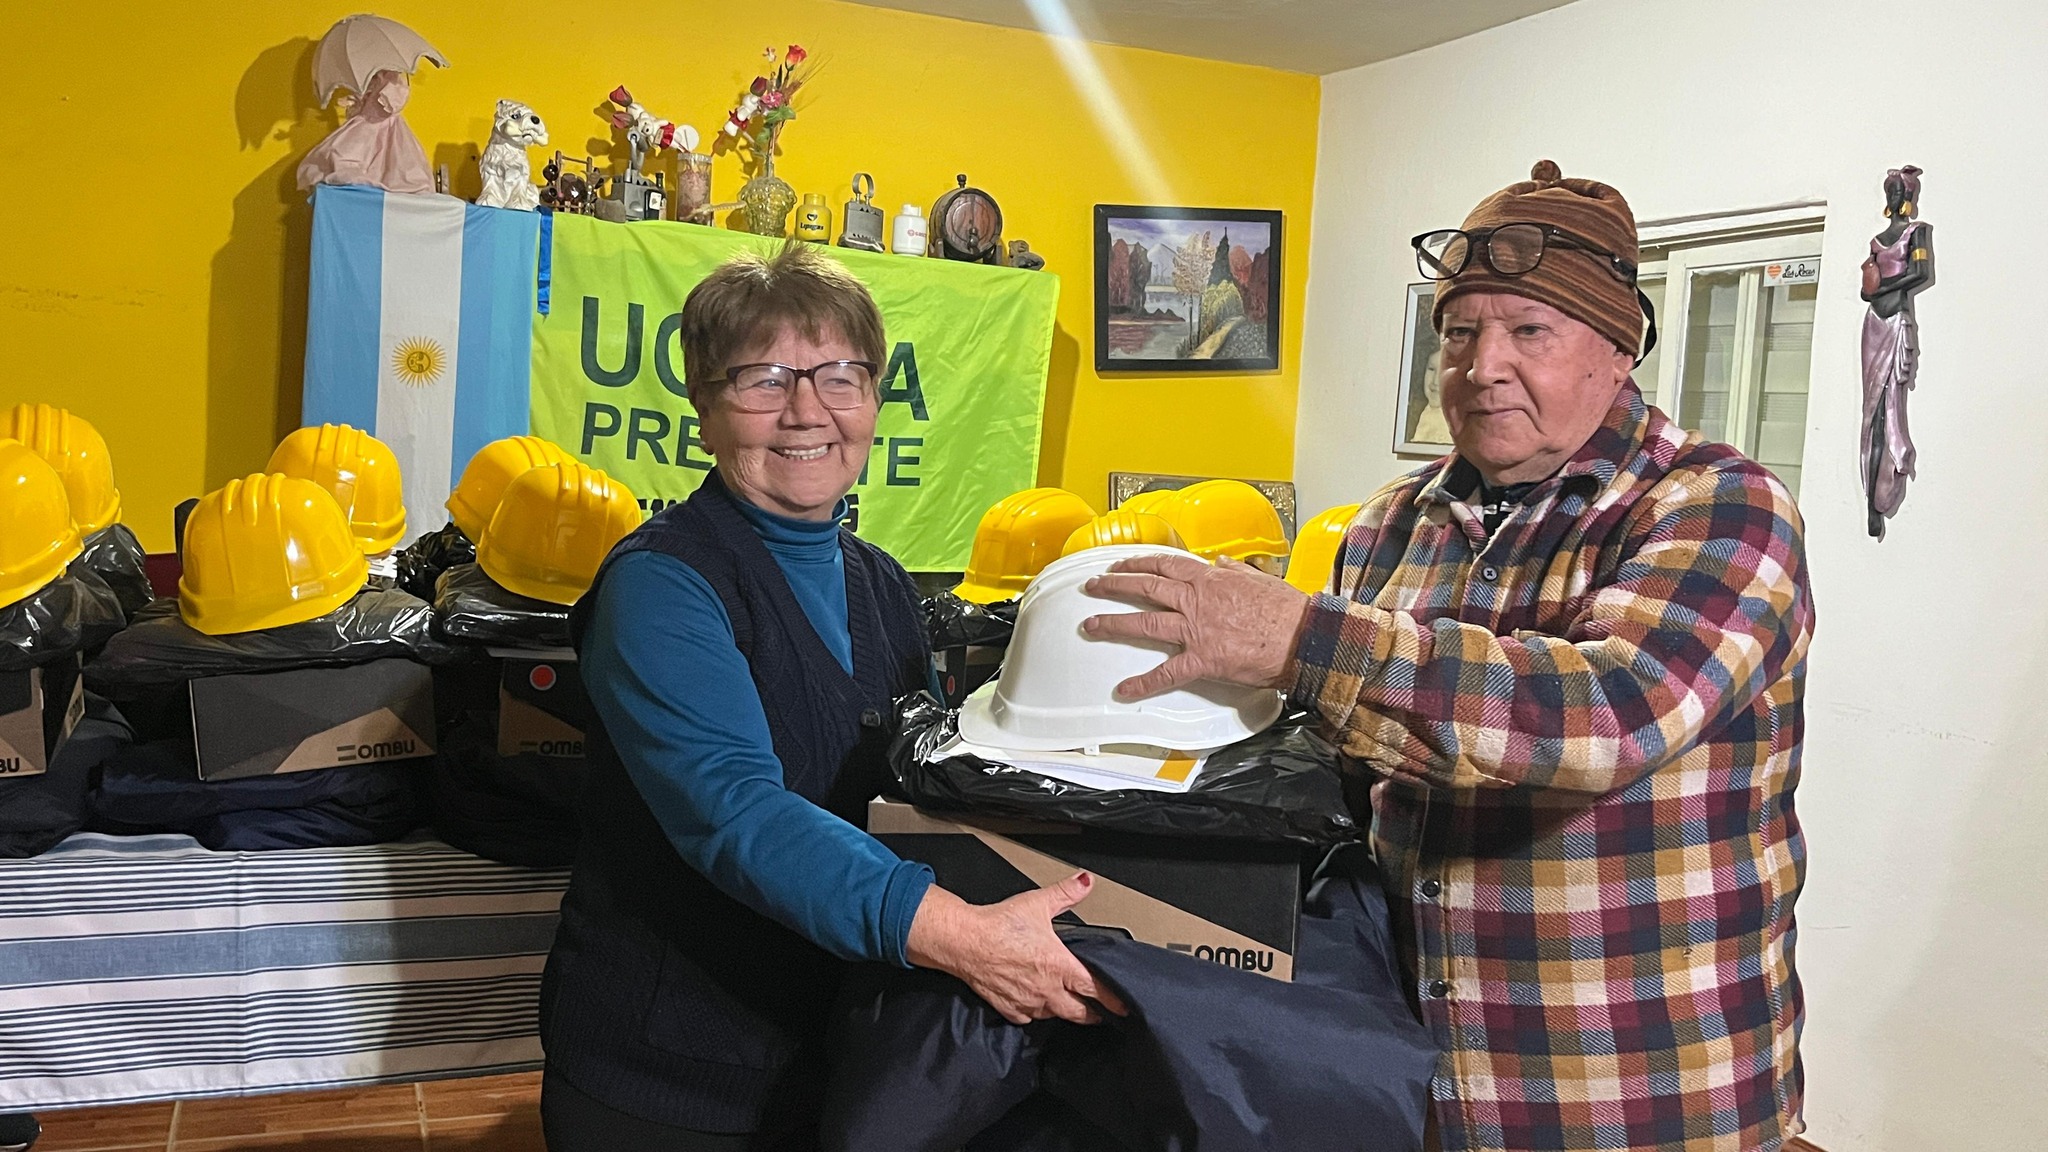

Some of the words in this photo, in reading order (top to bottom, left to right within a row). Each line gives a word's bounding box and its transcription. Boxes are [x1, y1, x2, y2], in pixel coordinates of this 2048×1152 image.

[357, 739, 416, 759] OMBU
[540, 741, 583, 755] OMB
[1194, 944, 1274, 972] OMBU
